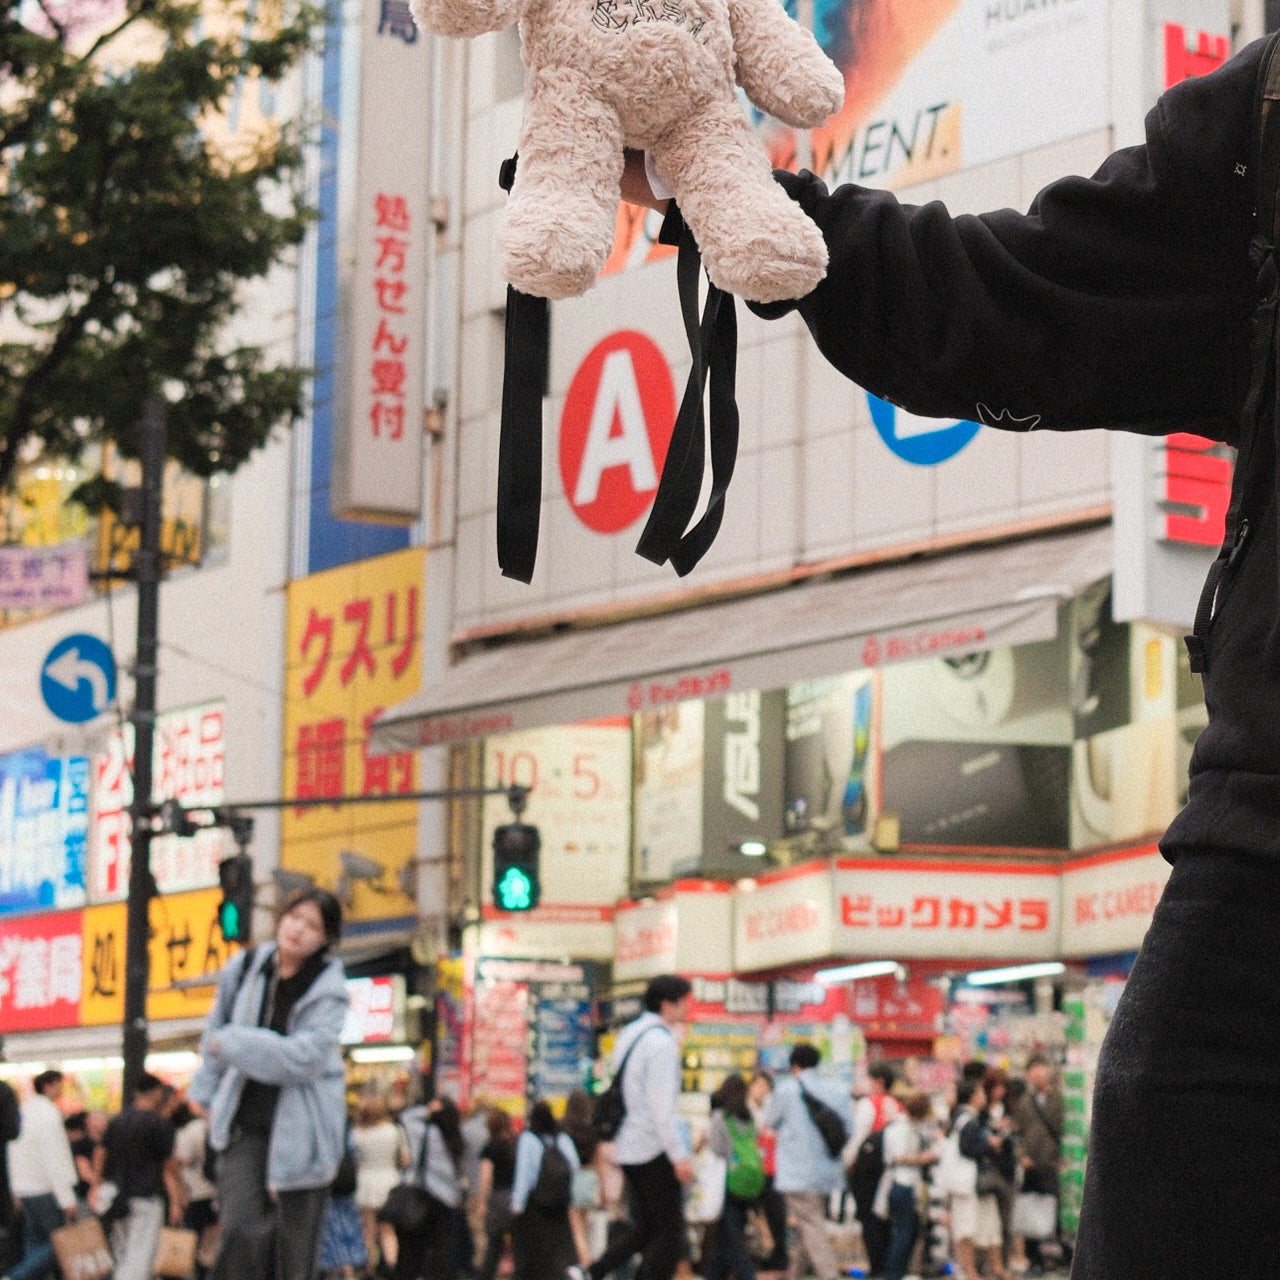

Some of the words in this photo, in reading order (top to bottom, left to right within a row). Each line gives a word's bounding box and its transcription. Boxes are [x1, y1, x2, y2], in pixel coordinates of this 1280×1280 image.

[812, 102, 950, 183] MENT.
[573, 348, 658, 506] A
[301, 585, 417, 698] クスリ
[840, 894, 1050, 932] ビックカメラ
